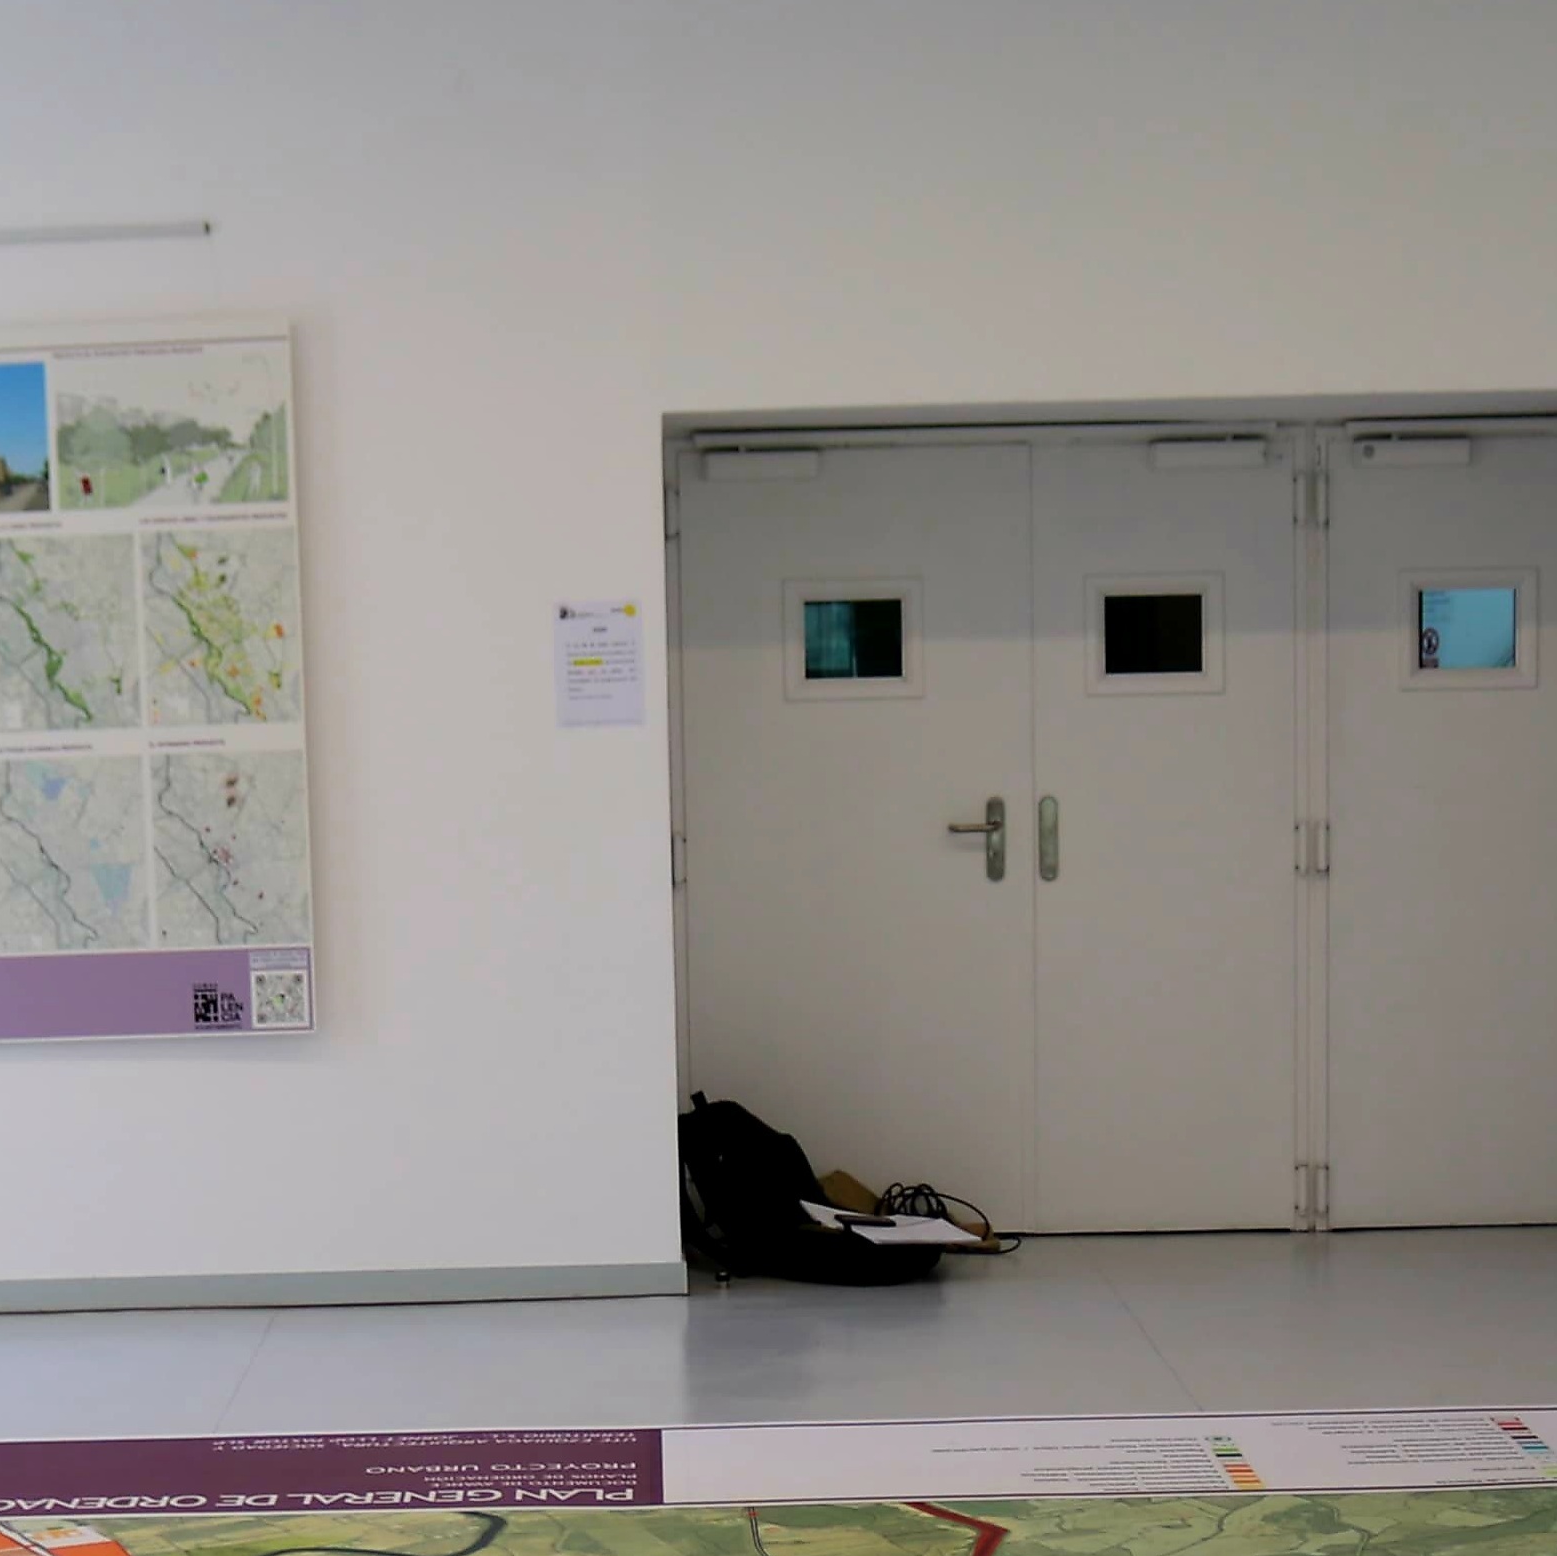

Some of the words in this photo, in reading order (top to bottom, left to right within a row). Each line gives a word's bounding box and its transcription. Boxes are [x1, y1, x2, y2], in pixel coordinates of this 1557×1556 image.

[365, 1465, 479, 1474] URBANO
[491, 1462, 637, 1471] PROYECTO
[215, 1494, 278, 1507] DE
[287, 1489, 502, 1505] GENERAL
[514, 1488, 634, 1501] PLAN
